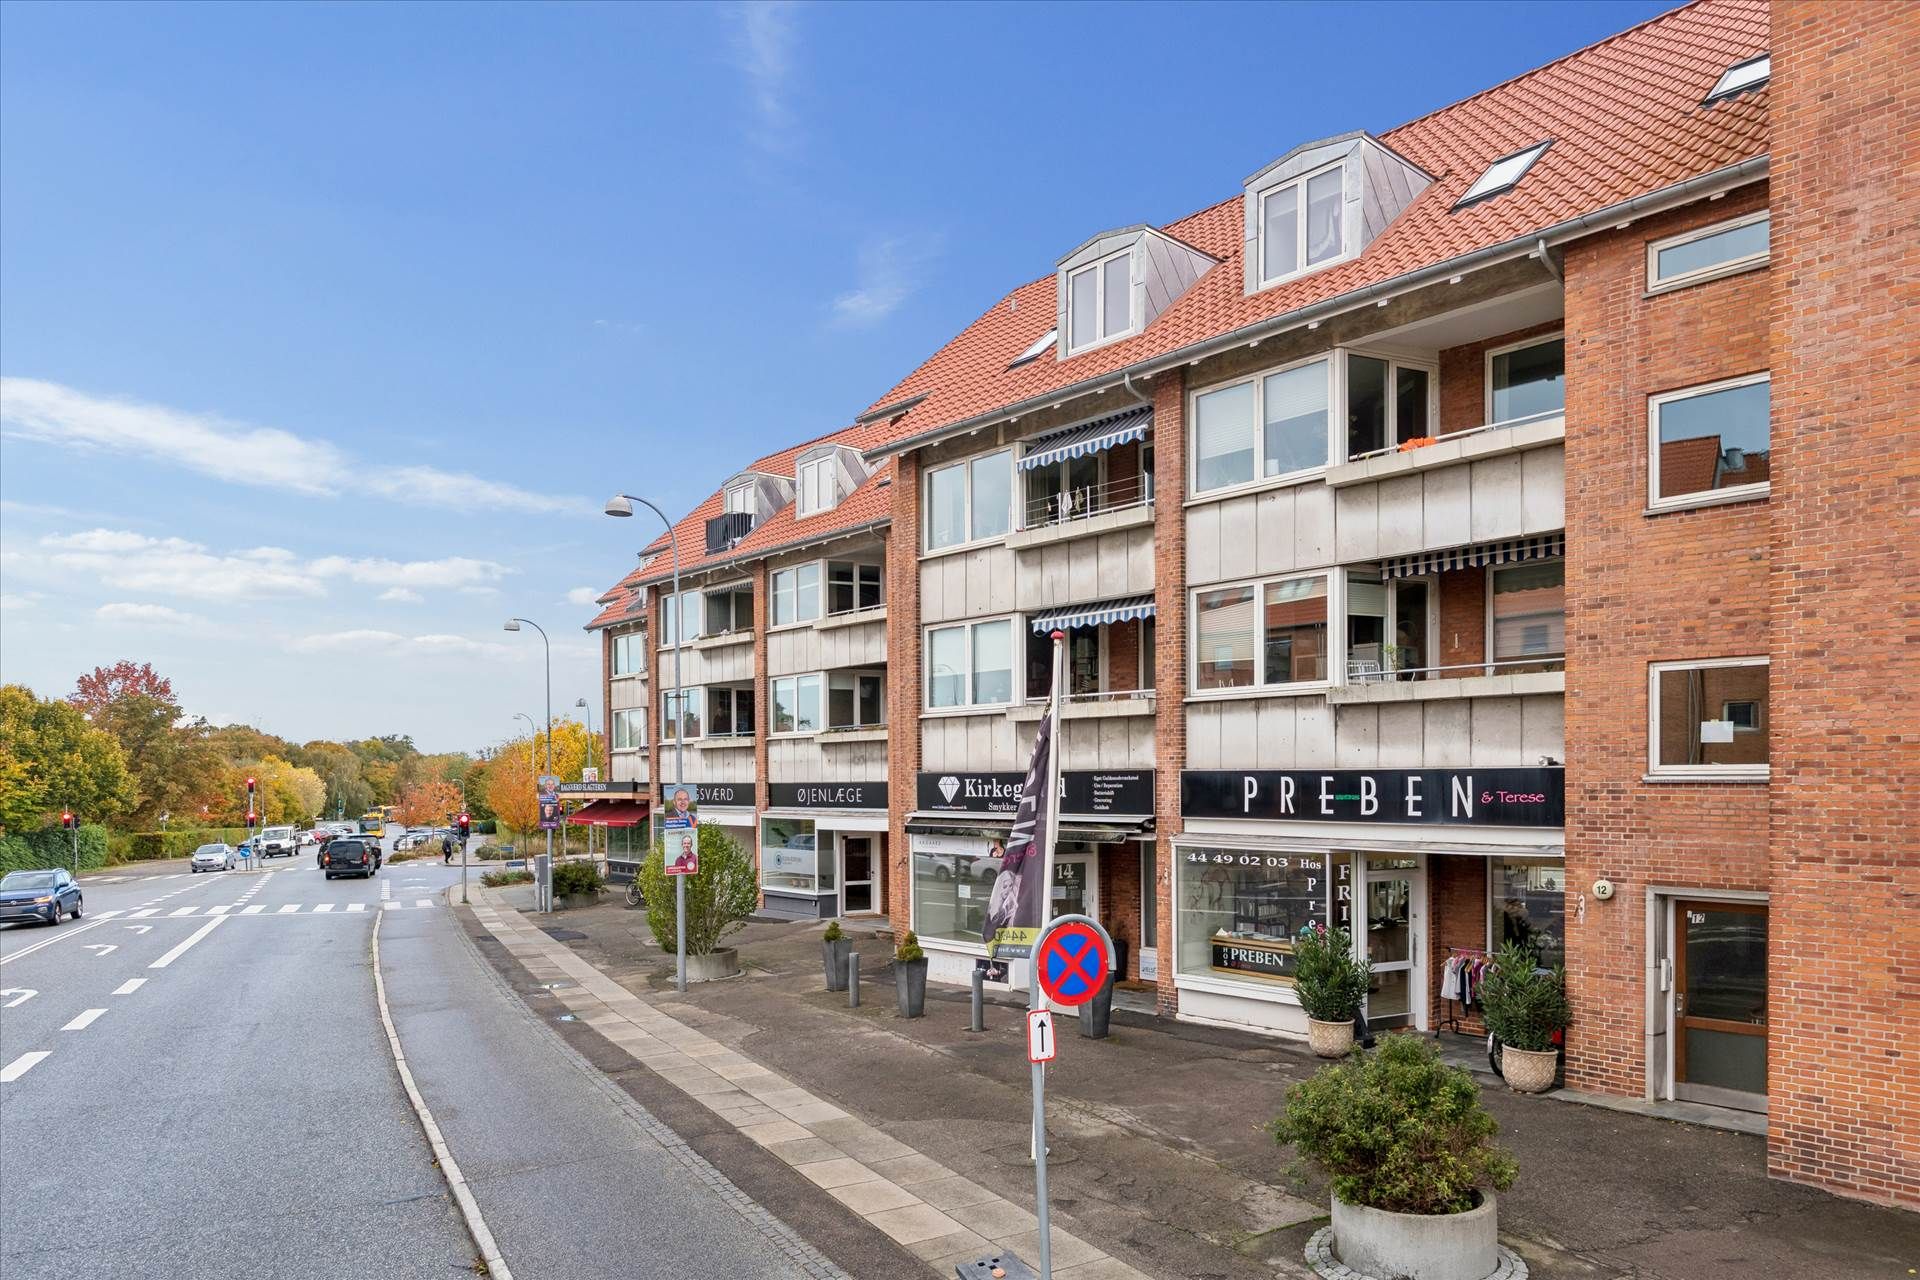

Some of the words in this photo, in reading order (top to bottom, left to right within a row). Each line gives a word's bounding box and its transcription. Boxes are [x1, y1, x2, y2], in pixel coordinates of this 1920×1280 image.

[797, 788, 863, 805] ØJENLÆGE
[964, 778, 1068, 801] Kirkegd
[1244, 776, 1473, 818] PREBEN
[1481, 791, 1494, 803] &
[1496, 791, 1545, 803] Terese
[988, 802, 1018, 812] Smykker
[1187, 853, 1208, 863] 44
[1213, 854, 1234, 864] 49
[1239, 855, 1261, 866] 02
[1266, 857, 1289, 868] 03
[1300, 859, 1321, 869] Hos
[1056, 864, 1074, 879] 14
[1597, 885, 1607, 895] 12
[1231, 947, 1284, 967] PREBEN
